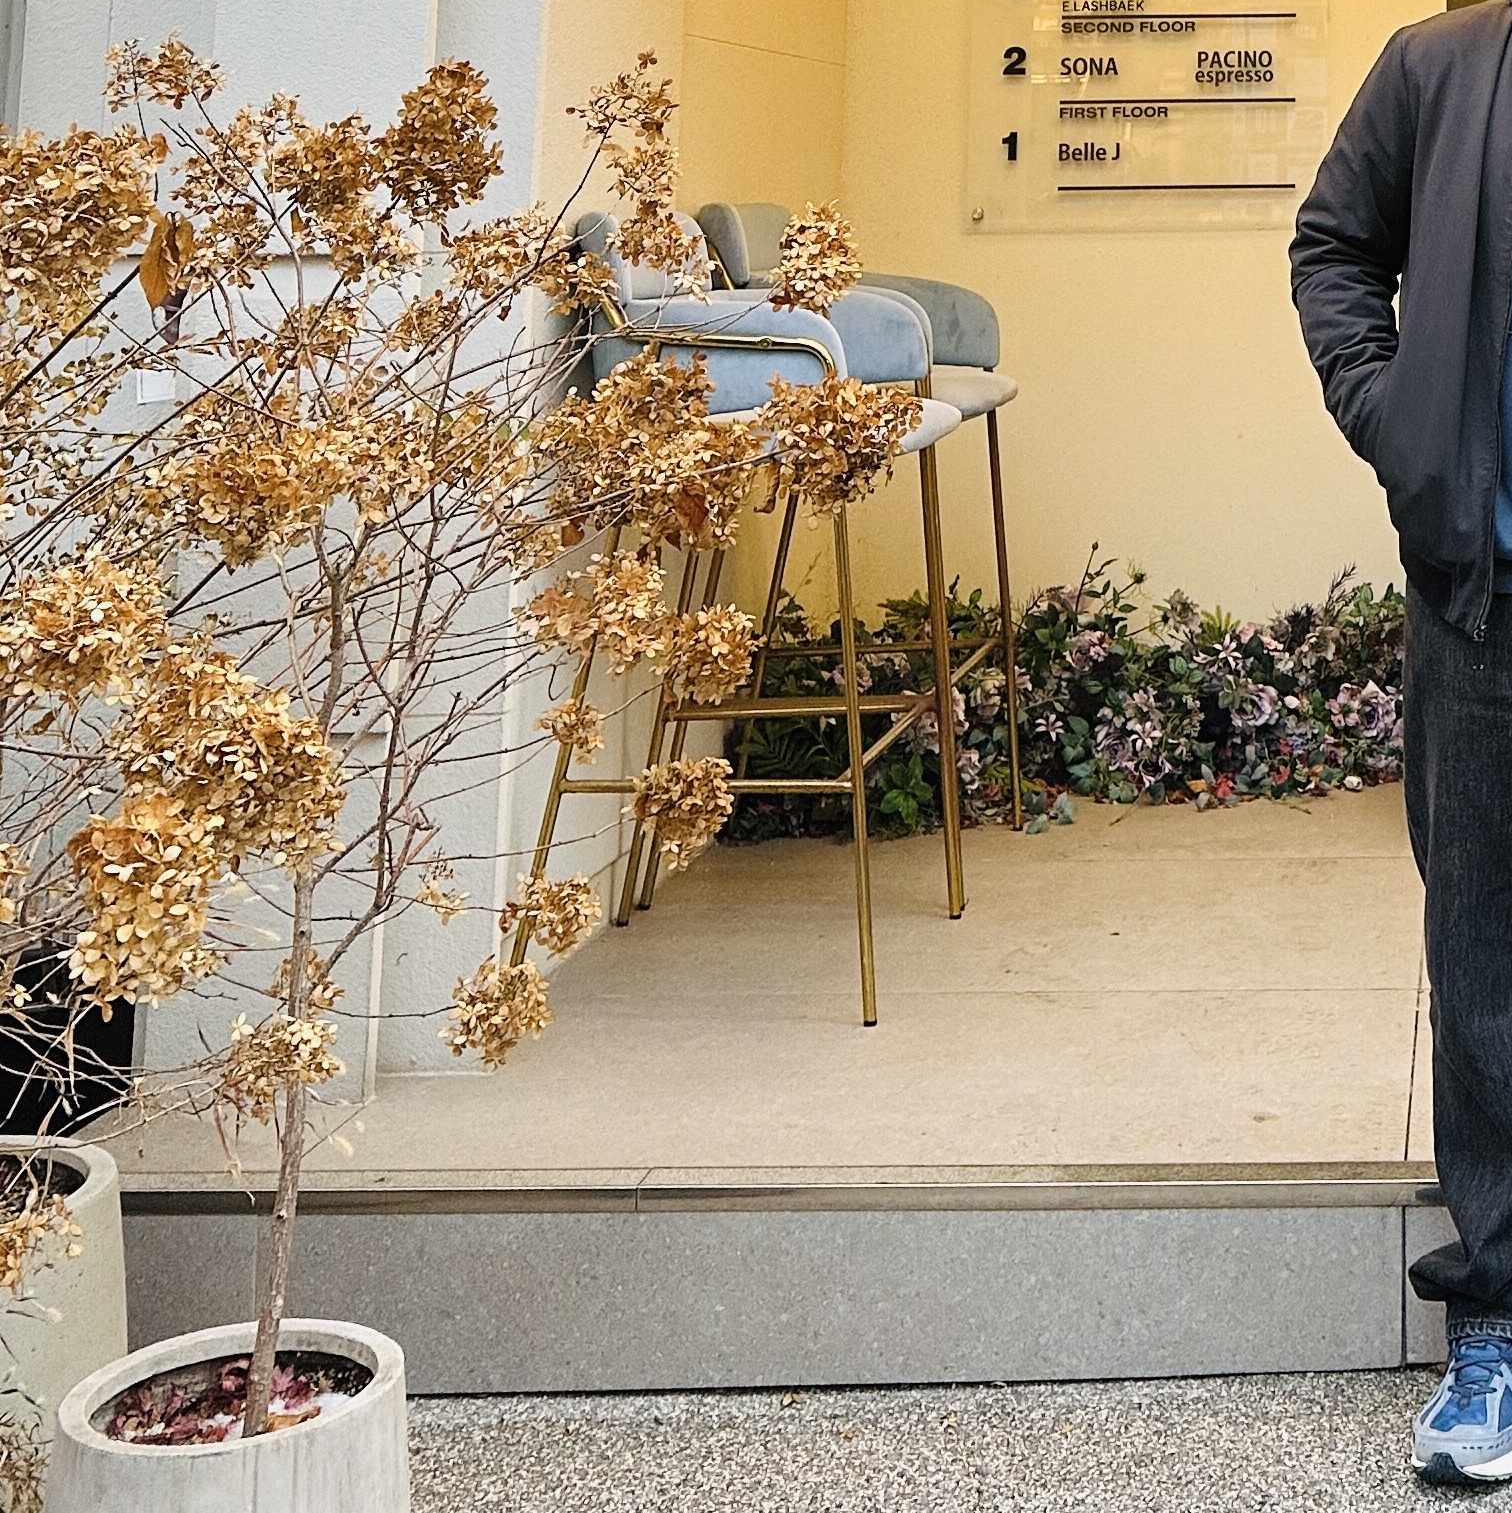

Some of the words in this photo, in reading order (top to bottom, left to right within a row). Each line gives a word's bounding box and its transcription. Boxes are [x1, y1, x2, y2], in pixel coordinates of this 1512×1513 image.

[1061, 21, 1135, 34] SECOND
[1140, 20, 1196, 33] FLOOR
[1002, 47, 1027, 76] 2
[1060, 57, 1119, 77] SONA
[1197, 50, 1273, 69] PACINO
[1195, 69, 1274, 87] espresso
[1059, 106, 1107, 119] FIRST
[1112, 106, 1169, 118] FLOOR
[1001, 131, 1018, 161] 1
[1058, 142, 1107, 162] Belle
[1111, 142, 1121, 163] J
